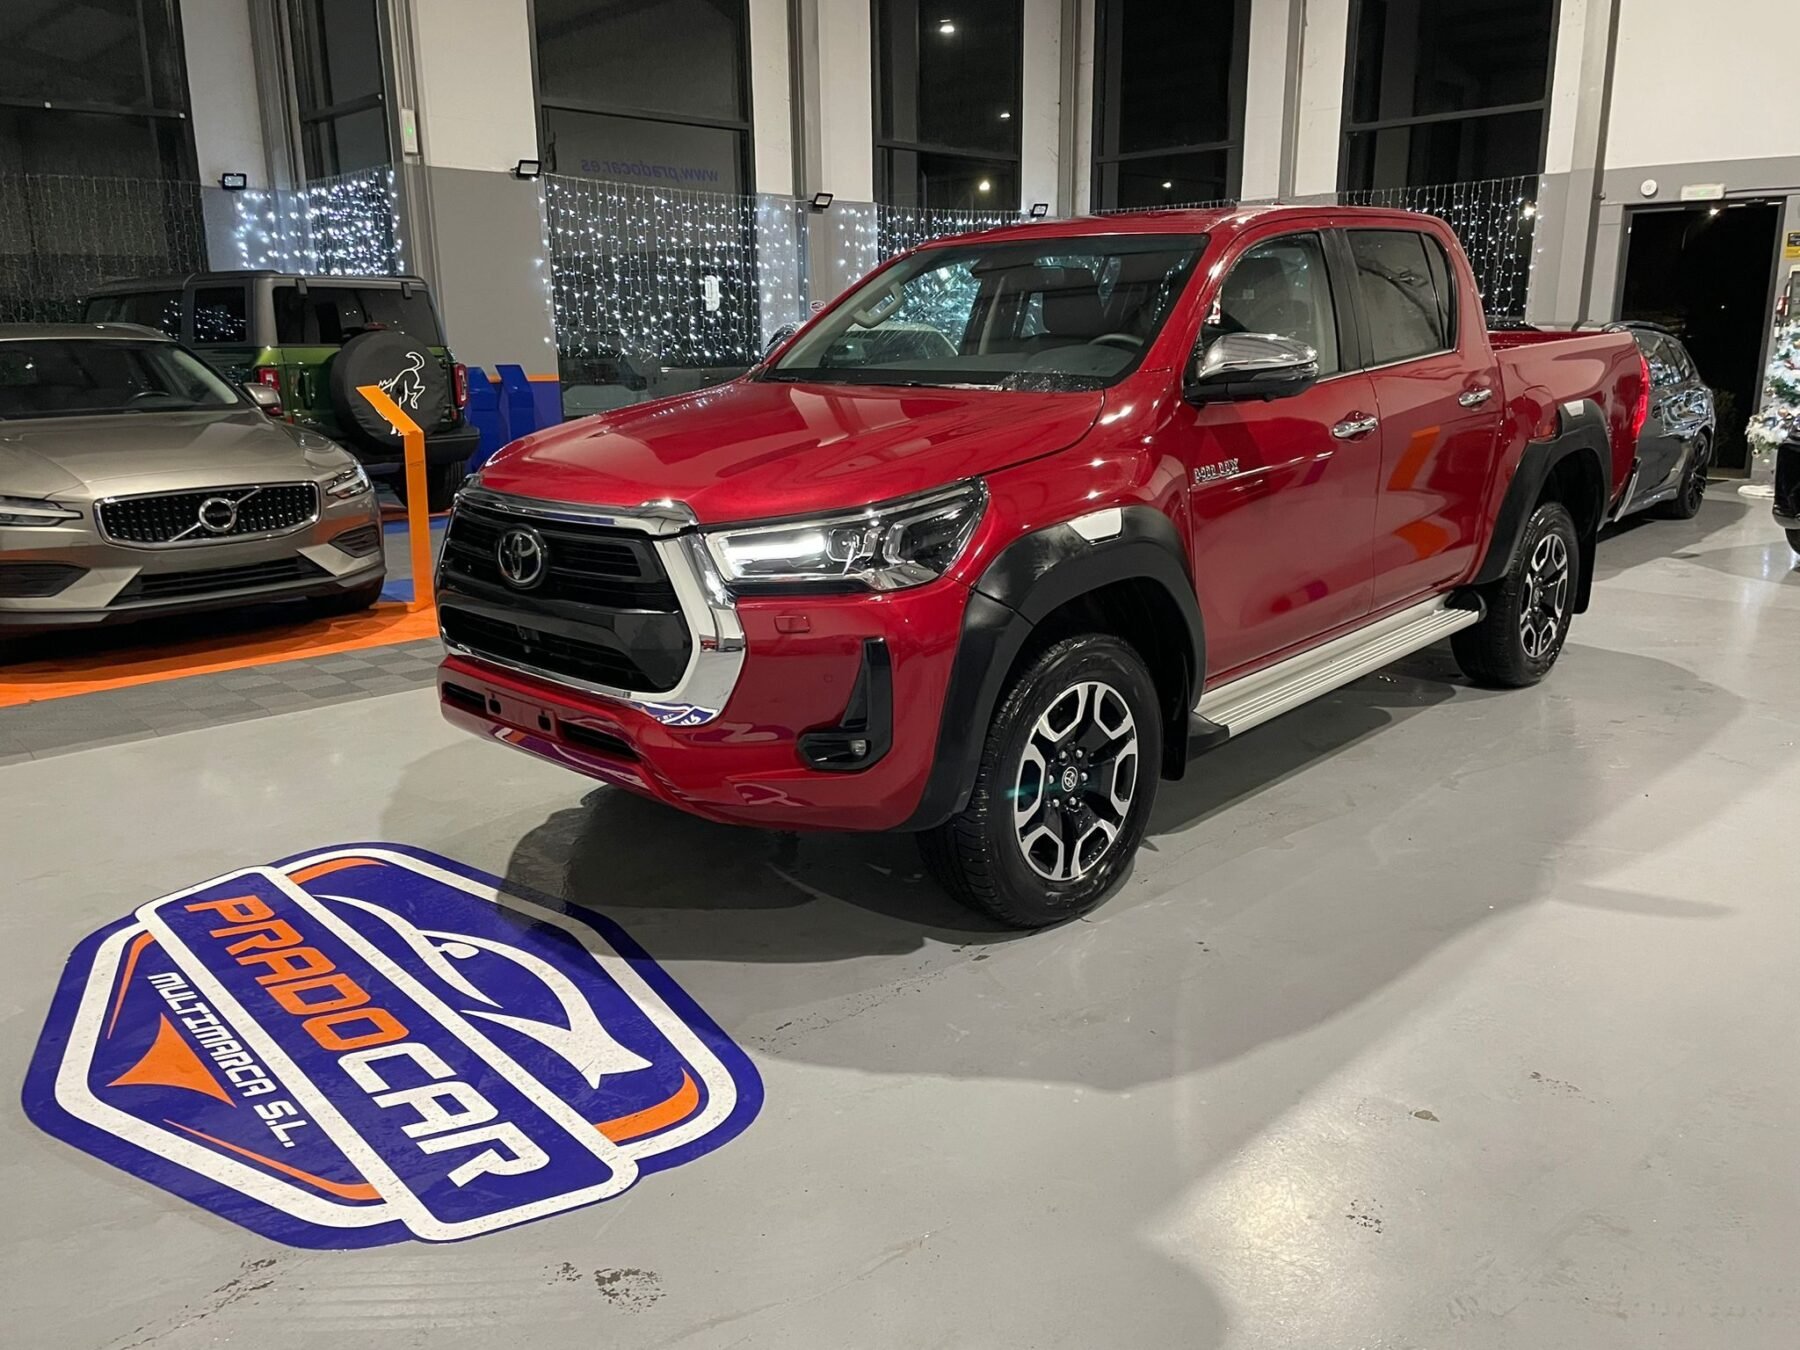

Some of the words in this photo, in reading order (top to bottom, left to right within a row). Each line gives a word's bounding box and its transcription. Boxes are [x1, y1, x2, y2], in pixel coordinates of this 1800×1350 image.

[147, 971, 277, 1097] MULTIMARCA
[253, 1100, 307, 1149] S.L.
[184, 895, 551, 1188] PRADOCAR
